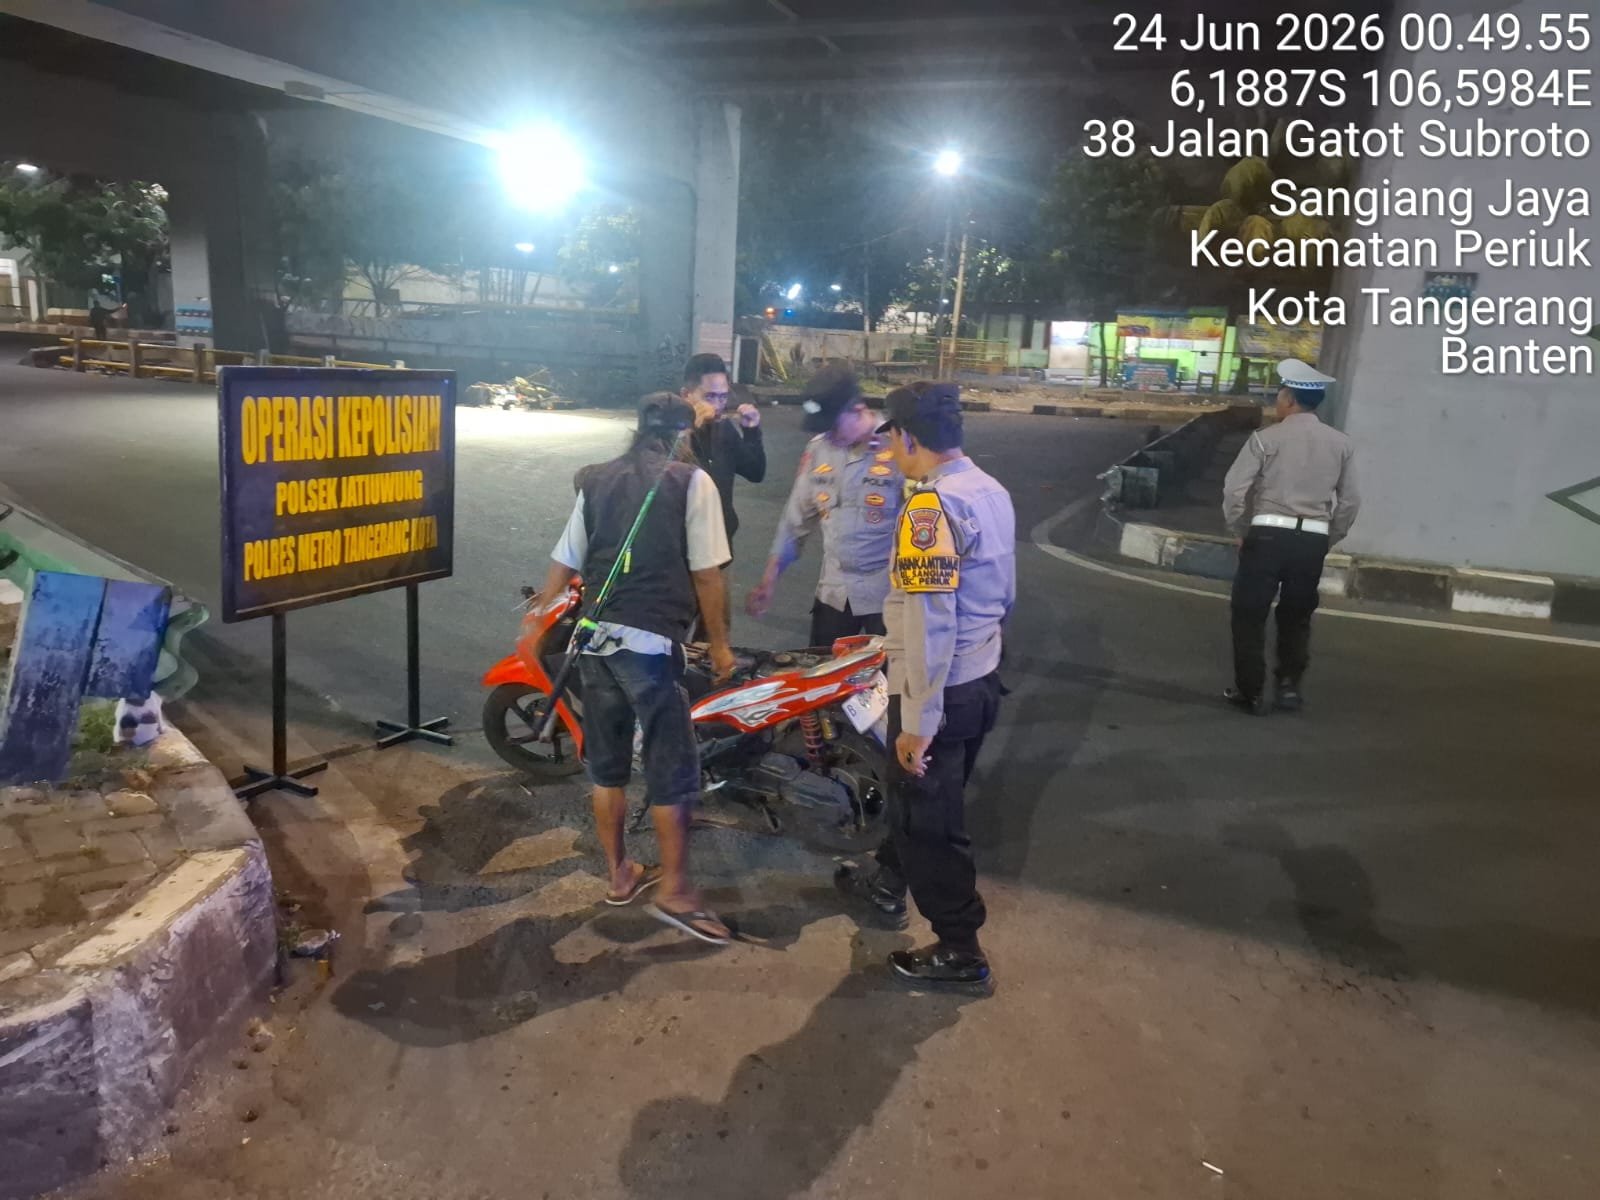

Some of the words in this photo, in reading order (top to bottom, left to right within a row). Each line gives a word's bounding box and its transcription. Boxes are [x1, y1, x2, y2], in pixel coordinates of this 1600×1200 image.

[241, 395, 334, 465] OPERASI
[337, 394, 441, 458] KEPOLISIAN
[276, 477, 338, 516] POLSEK
[340, 469, 423, 508] JATIUWUNG
[244, 535, 295, 582] POLRES
[297, 529, 341, 572] METRO
[343, 519, 409, 564] TANGERANG
